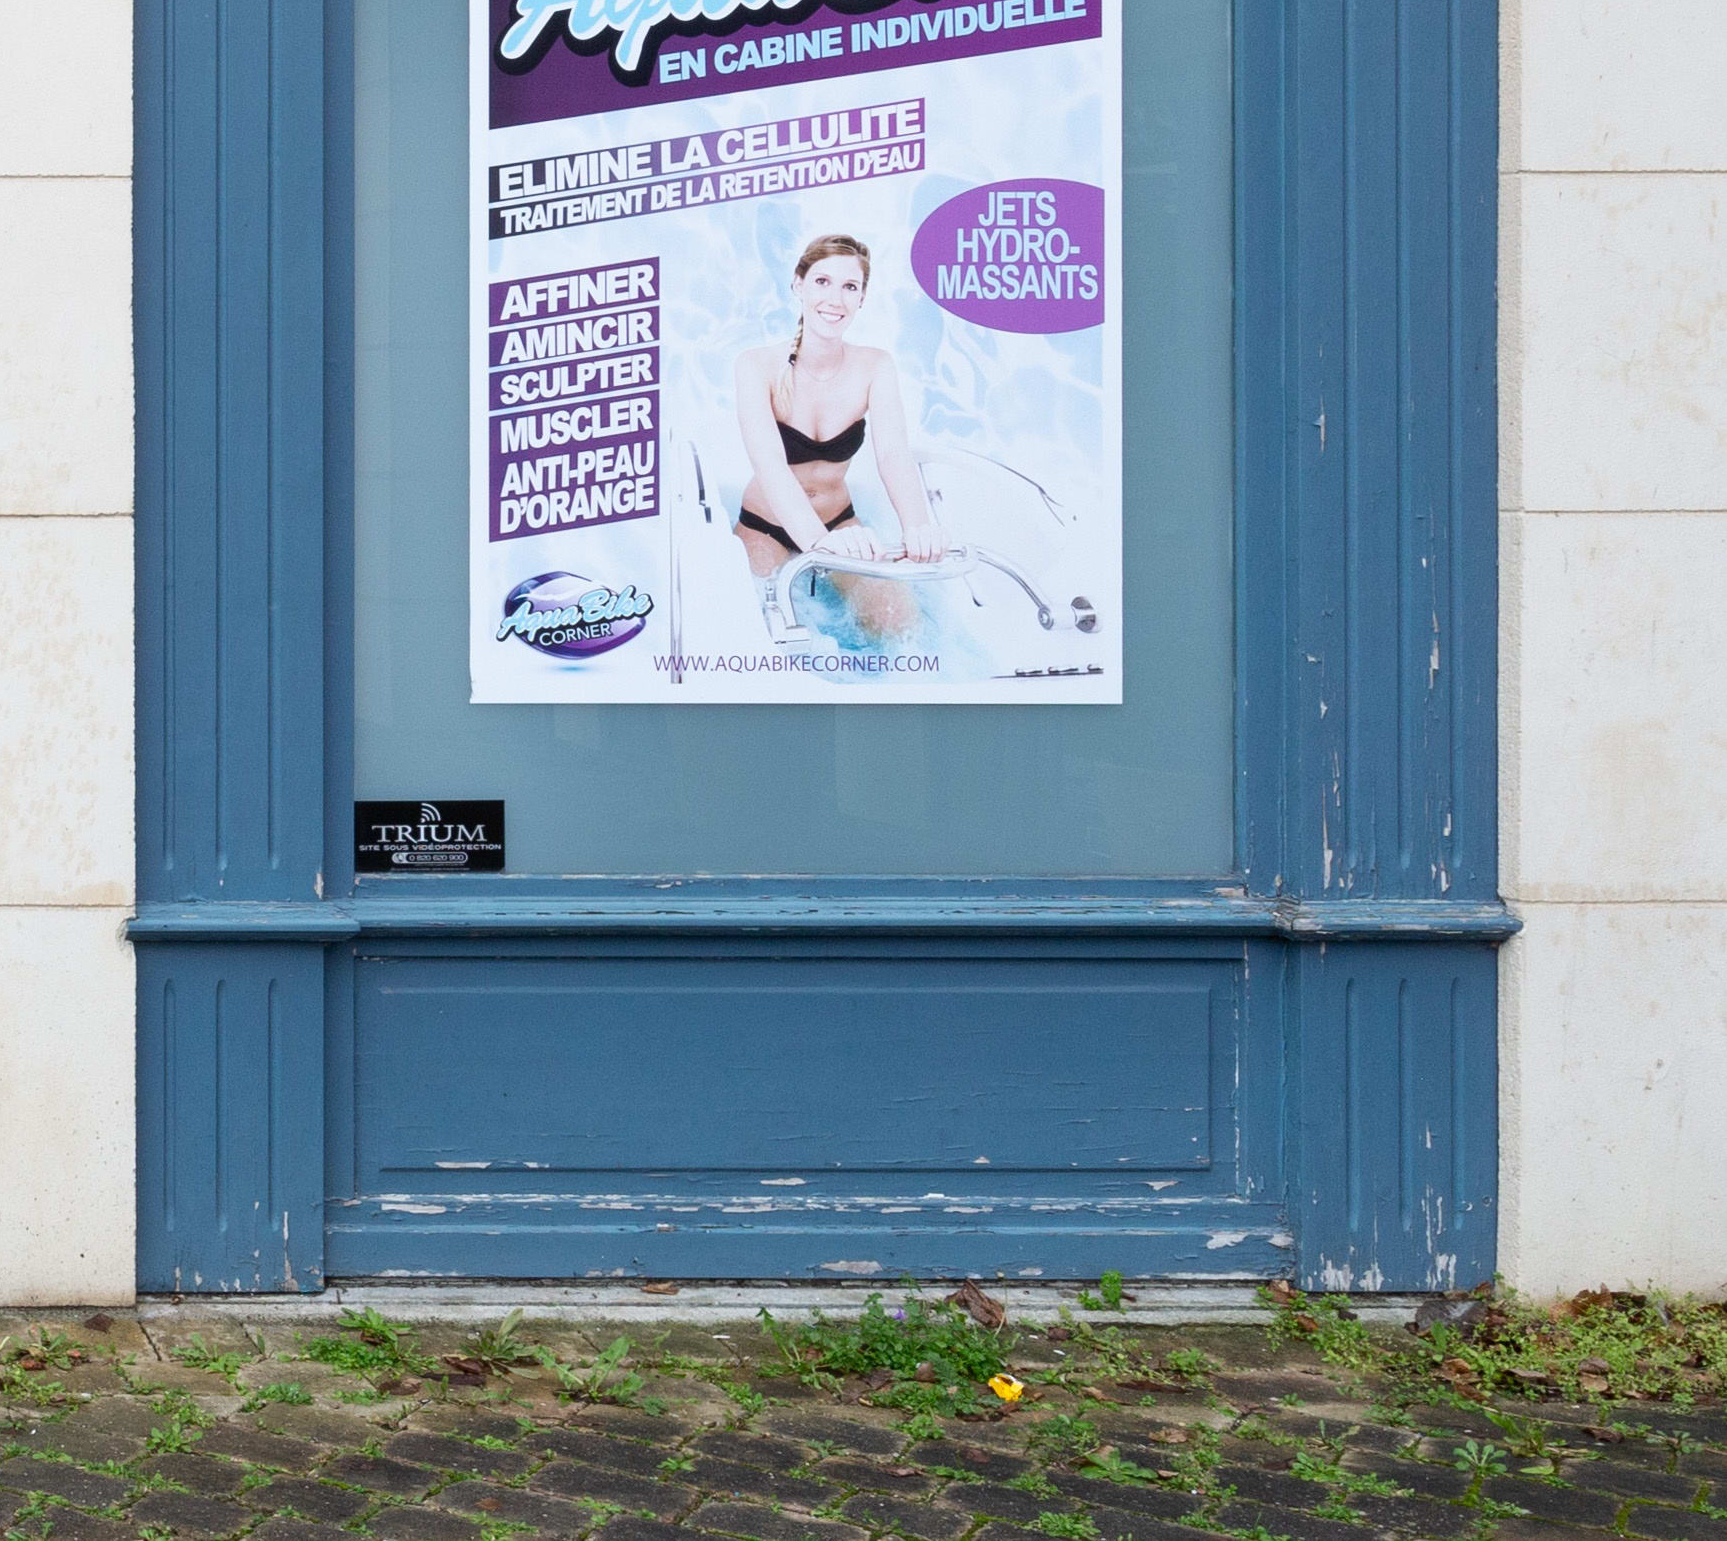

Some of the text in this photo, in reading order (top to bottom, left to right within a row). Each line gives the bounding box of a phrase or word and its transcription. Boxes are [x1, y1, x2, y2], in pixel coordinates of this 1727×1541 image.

[658, 49, 706, 85] EN
[713, 26, 844, 76] CABINE
[498, 100, 923, 201] ELIMINE LA CELLULITE
[499, 142, 923, 236] TRAITEMENT DE LA RETENTION D'EAU
[977, 190, 1057, 227] JETS
[956, 227, 1081, 264] HYDRO-
[499, 264, 657, 321] AFFINER
[937, 264, 1099, 300] MASSANTS
[499, 310, 655, 365] AMINCIR
[499, 352, 654, 406] SCULPTER
[499, 396, 654, 455] MUSCLER
[499, 439, 656, 498] ANTI-PEAU
[499, 474, 656, 535] D'ORANGE
[538, 622, 612, 647] CORNER
[652, 655, 940, 674] WWW.AQUABIKECORNER.COM
[371, 824, 488, 844] TRIUM
[408, 854, 415, 862] 0
